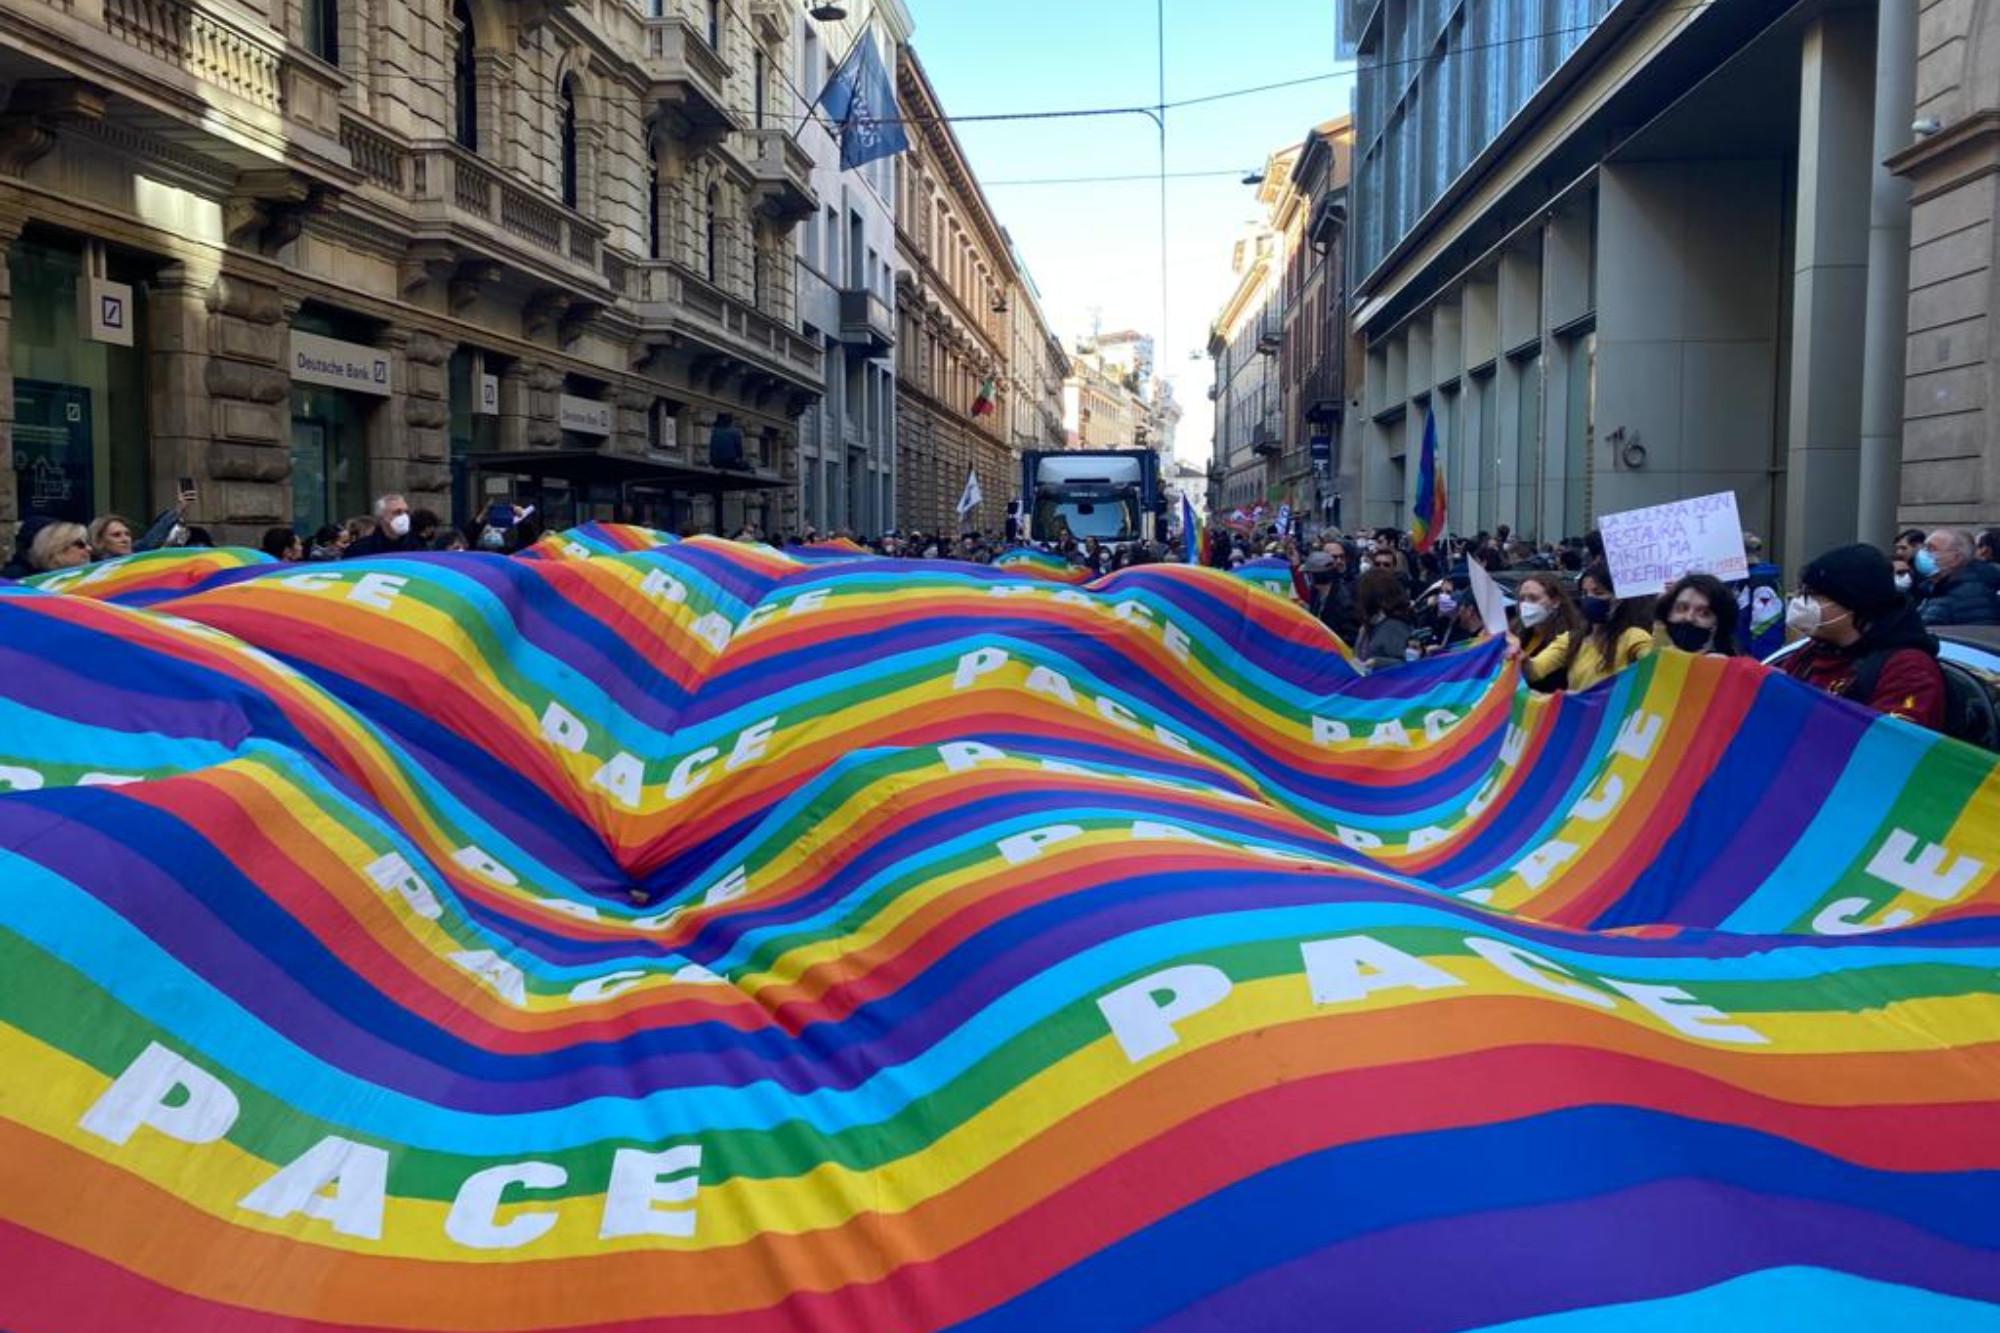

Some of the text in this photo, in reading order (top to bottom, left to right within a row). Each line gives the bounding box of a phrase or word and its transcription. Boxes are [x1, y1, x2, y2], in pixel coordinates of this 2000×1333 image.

[297, 352, 370, 380] Deutsche Bank
[280, 572, 409, 610] CE
[640, 568, 832, 655] PACE
[988, 585, 1191, 662] PACE
[540, 701, 779, 808] PACE
[953, 646, 1200, 756] PACE
[1311, 684, 1495, 746] PAC
[1458, 709, 1664, 903] ACE
[1812, 827, 1985, 936] CE
[1096, 935, 1771, 1064] PACE
[77, 1040, 702, 1249] PACE
